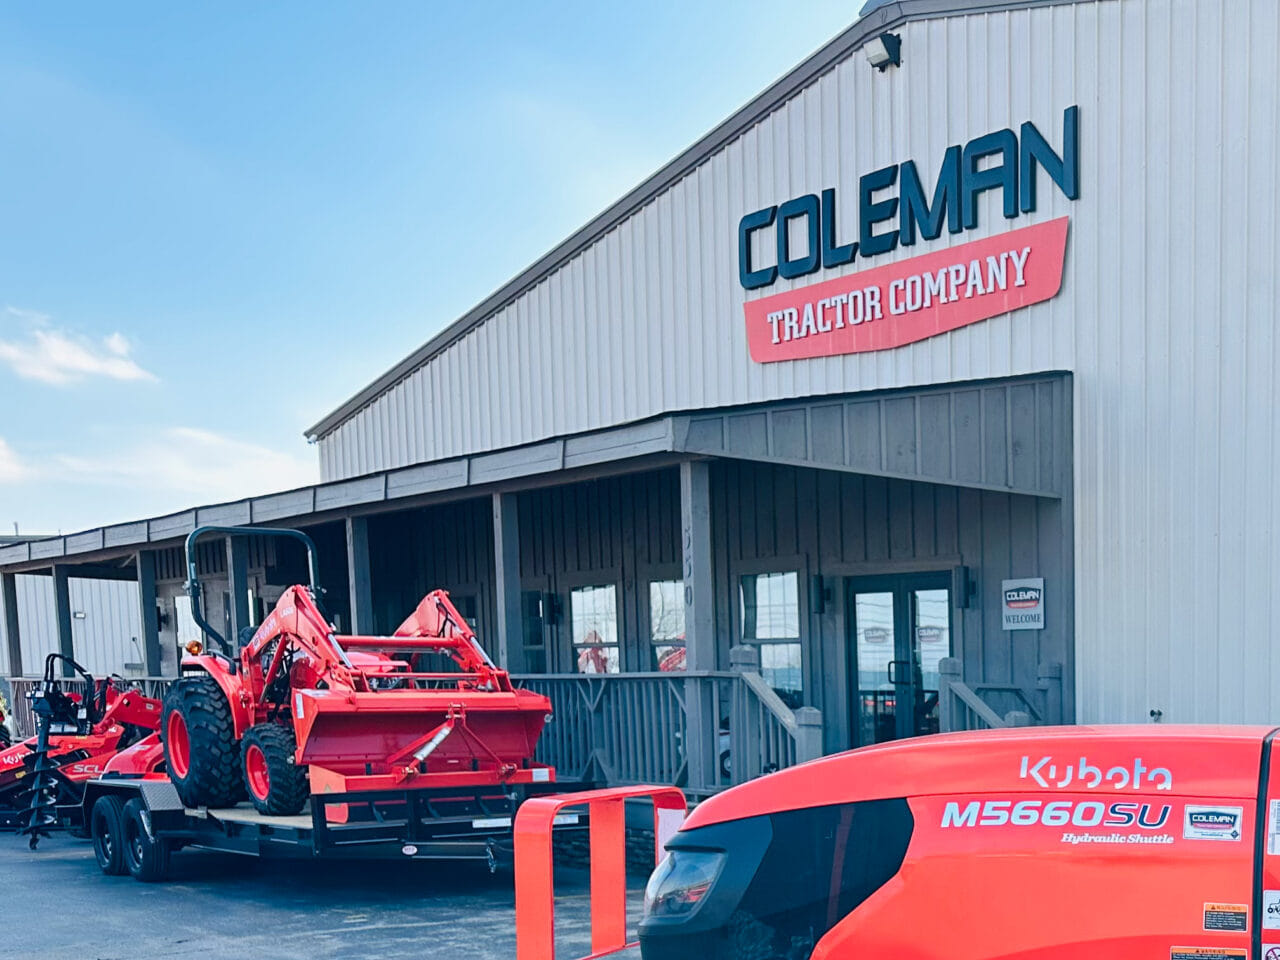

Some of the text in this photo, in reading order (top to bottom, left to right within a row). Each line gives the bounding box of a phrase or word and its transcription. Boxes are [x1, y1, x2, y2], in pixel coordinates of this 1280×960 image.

[739, 105, 1079, 290] COLEMAN
[767, 247, 1031, 345] TRACTOR COMPANY
[1006, 590, 1040, 601] COLEMAN
[1005, 613, 1041, 624] WELCOME
[1019, 756, 1172, 790] Kubota
[940, 800, 1172, 828] M5660SU
[1192, 814, 1235, 823] COLEMAN
[1061, 833, 1174, 845] Hydraulic Shuttle
